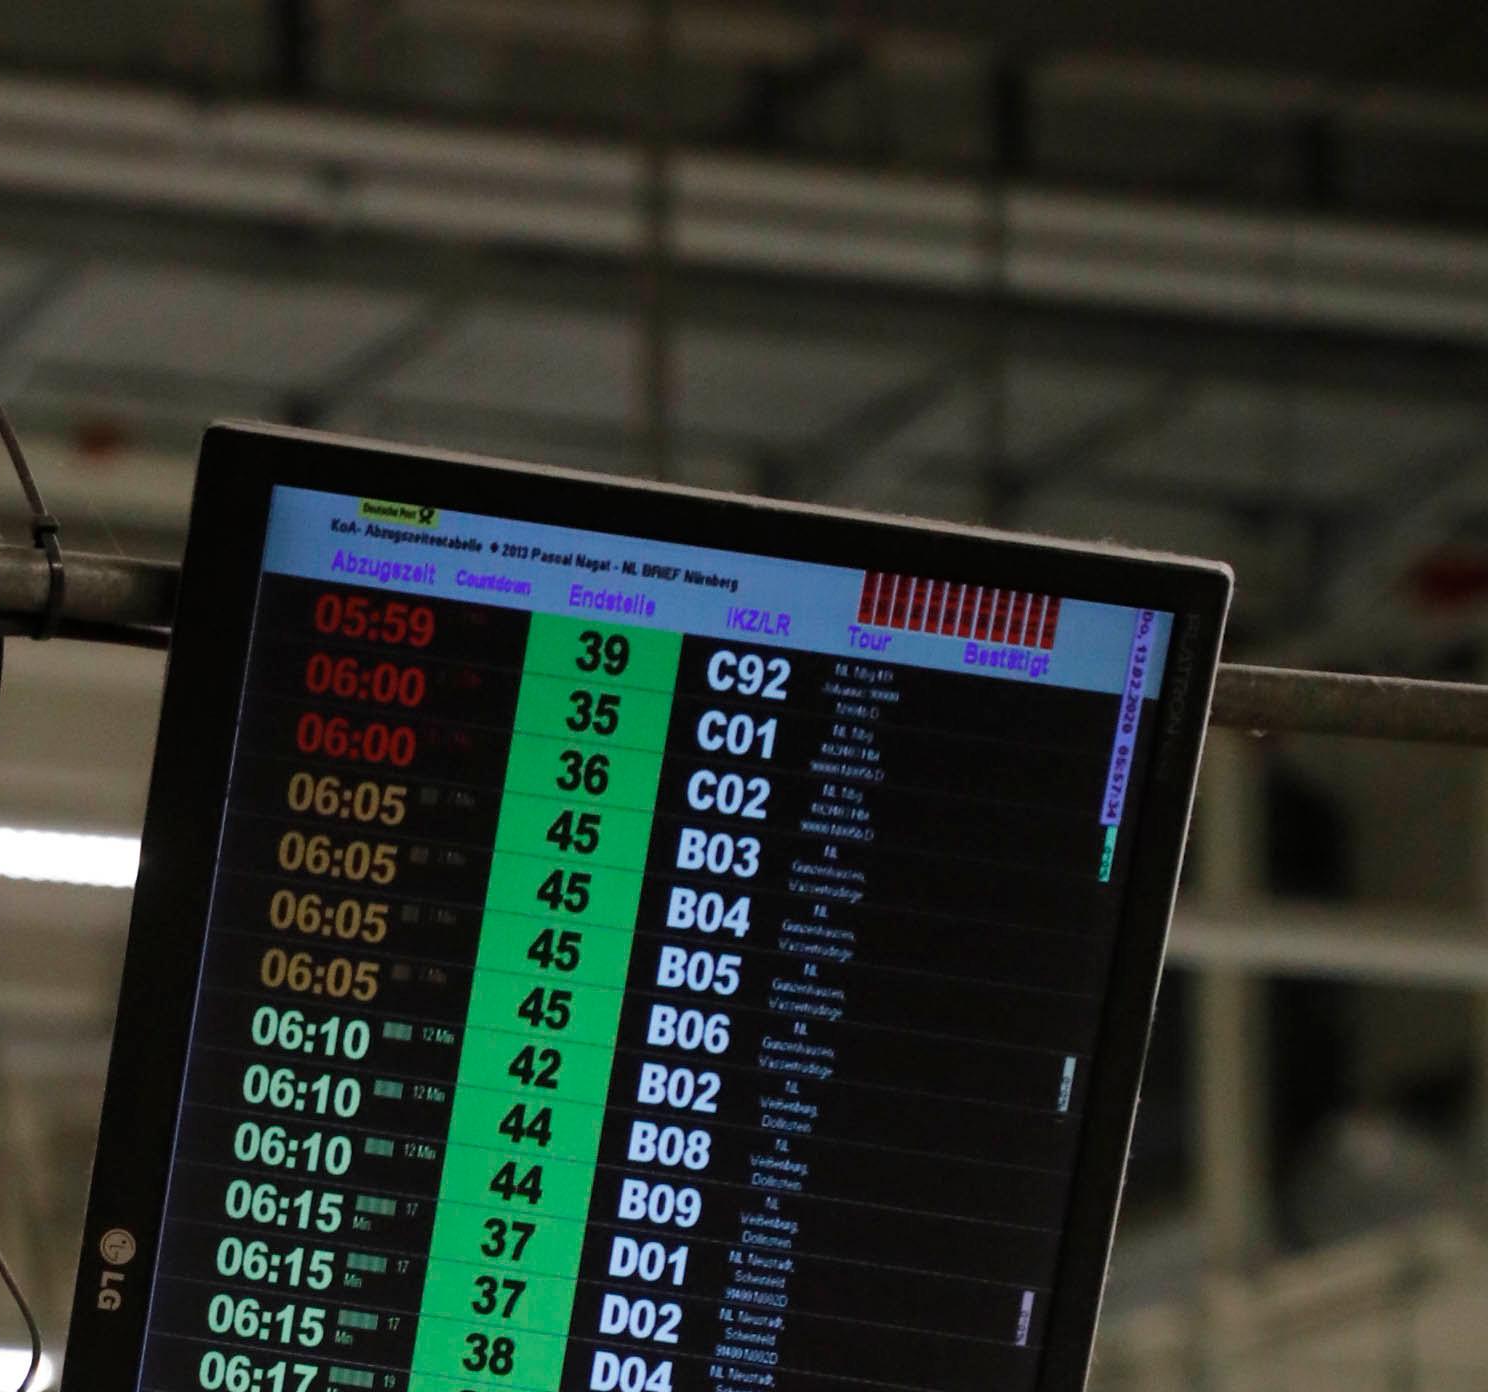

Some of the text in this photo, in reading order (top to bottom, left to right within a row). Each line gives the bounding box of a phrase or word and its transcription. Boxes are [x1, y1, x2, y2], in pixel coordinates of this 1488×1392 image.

[315, 592, 435, 648] 05:59
[575, 630, 630, 677] 39
[707, 649, 791, 700] C92
[330, 548, 437, 585] Abzugszeit
[568, 582, 656, 618] Endstelle
[726, 607, 792, 637] IKZ/LR
[847, 625, 892, 652] Tour
[306, 652, 426, 708] 06:00
[565, 689, 621, 736] 35
[696, 709, 778, 759] C01
[296, 712, 417, 767] 06:00
[556, 749, 610, 796] 36
[687, 769, 771, 820] C02
[287, 772, 407, 825] 06:05
[546, 809, 602, 855] 45
[676, 827, 761, 878] B03
[278, 831, 398, 885] 06:05
[536, 868, 592, 914] 45
[666, 886, 751, 938] B04
[269, 889, 389, 943] 06:05
[526, 928, 583, 973] 45
[656, 945, 742, 996] B05
[260, 948, 380, 1002] 06:05
[517, 986, 573, 1031] 45
[646, 1003, 731, 1054] B06
[251, 1006, 370, 1060] 06:10
[434, 1026, 458, 1045] Min
[508, 1045, 562, 1090] 42
[637, 1062, 721, 1113] B02
[242, 1064, 361, 1118] 06:10
[425, 1084, 449, 1103] Min
[498, 1103, 553, 1148] 44
[627, 1120, 712, 1170] B08
[234, 1121, 353, 1176] 06:10
[416, 1141, 440, 1161] Min
[489, 1161, 543, 1205] 44
[617, 1178, 702, 1228] B09
[350, 1213, 374, 1233] Min
[225, 1179, 344, 1233] 06:15
[480, 1217, 536, 1262] 37
[608, 1235, 689, 1286] D01
[341, 1270, 365, 1290] Min
[97, 1271, 125, 1311] LG
[207, 1294, 326, 1347] 06:15
[462, 1332, 516, 1376] 38
[216, 1237, 335, 1290] 06:15
[471, 1275, 527, 1319] 37
[599, 1293, 683, 1344] D02
[332, 1328, 356, 1348] Min
